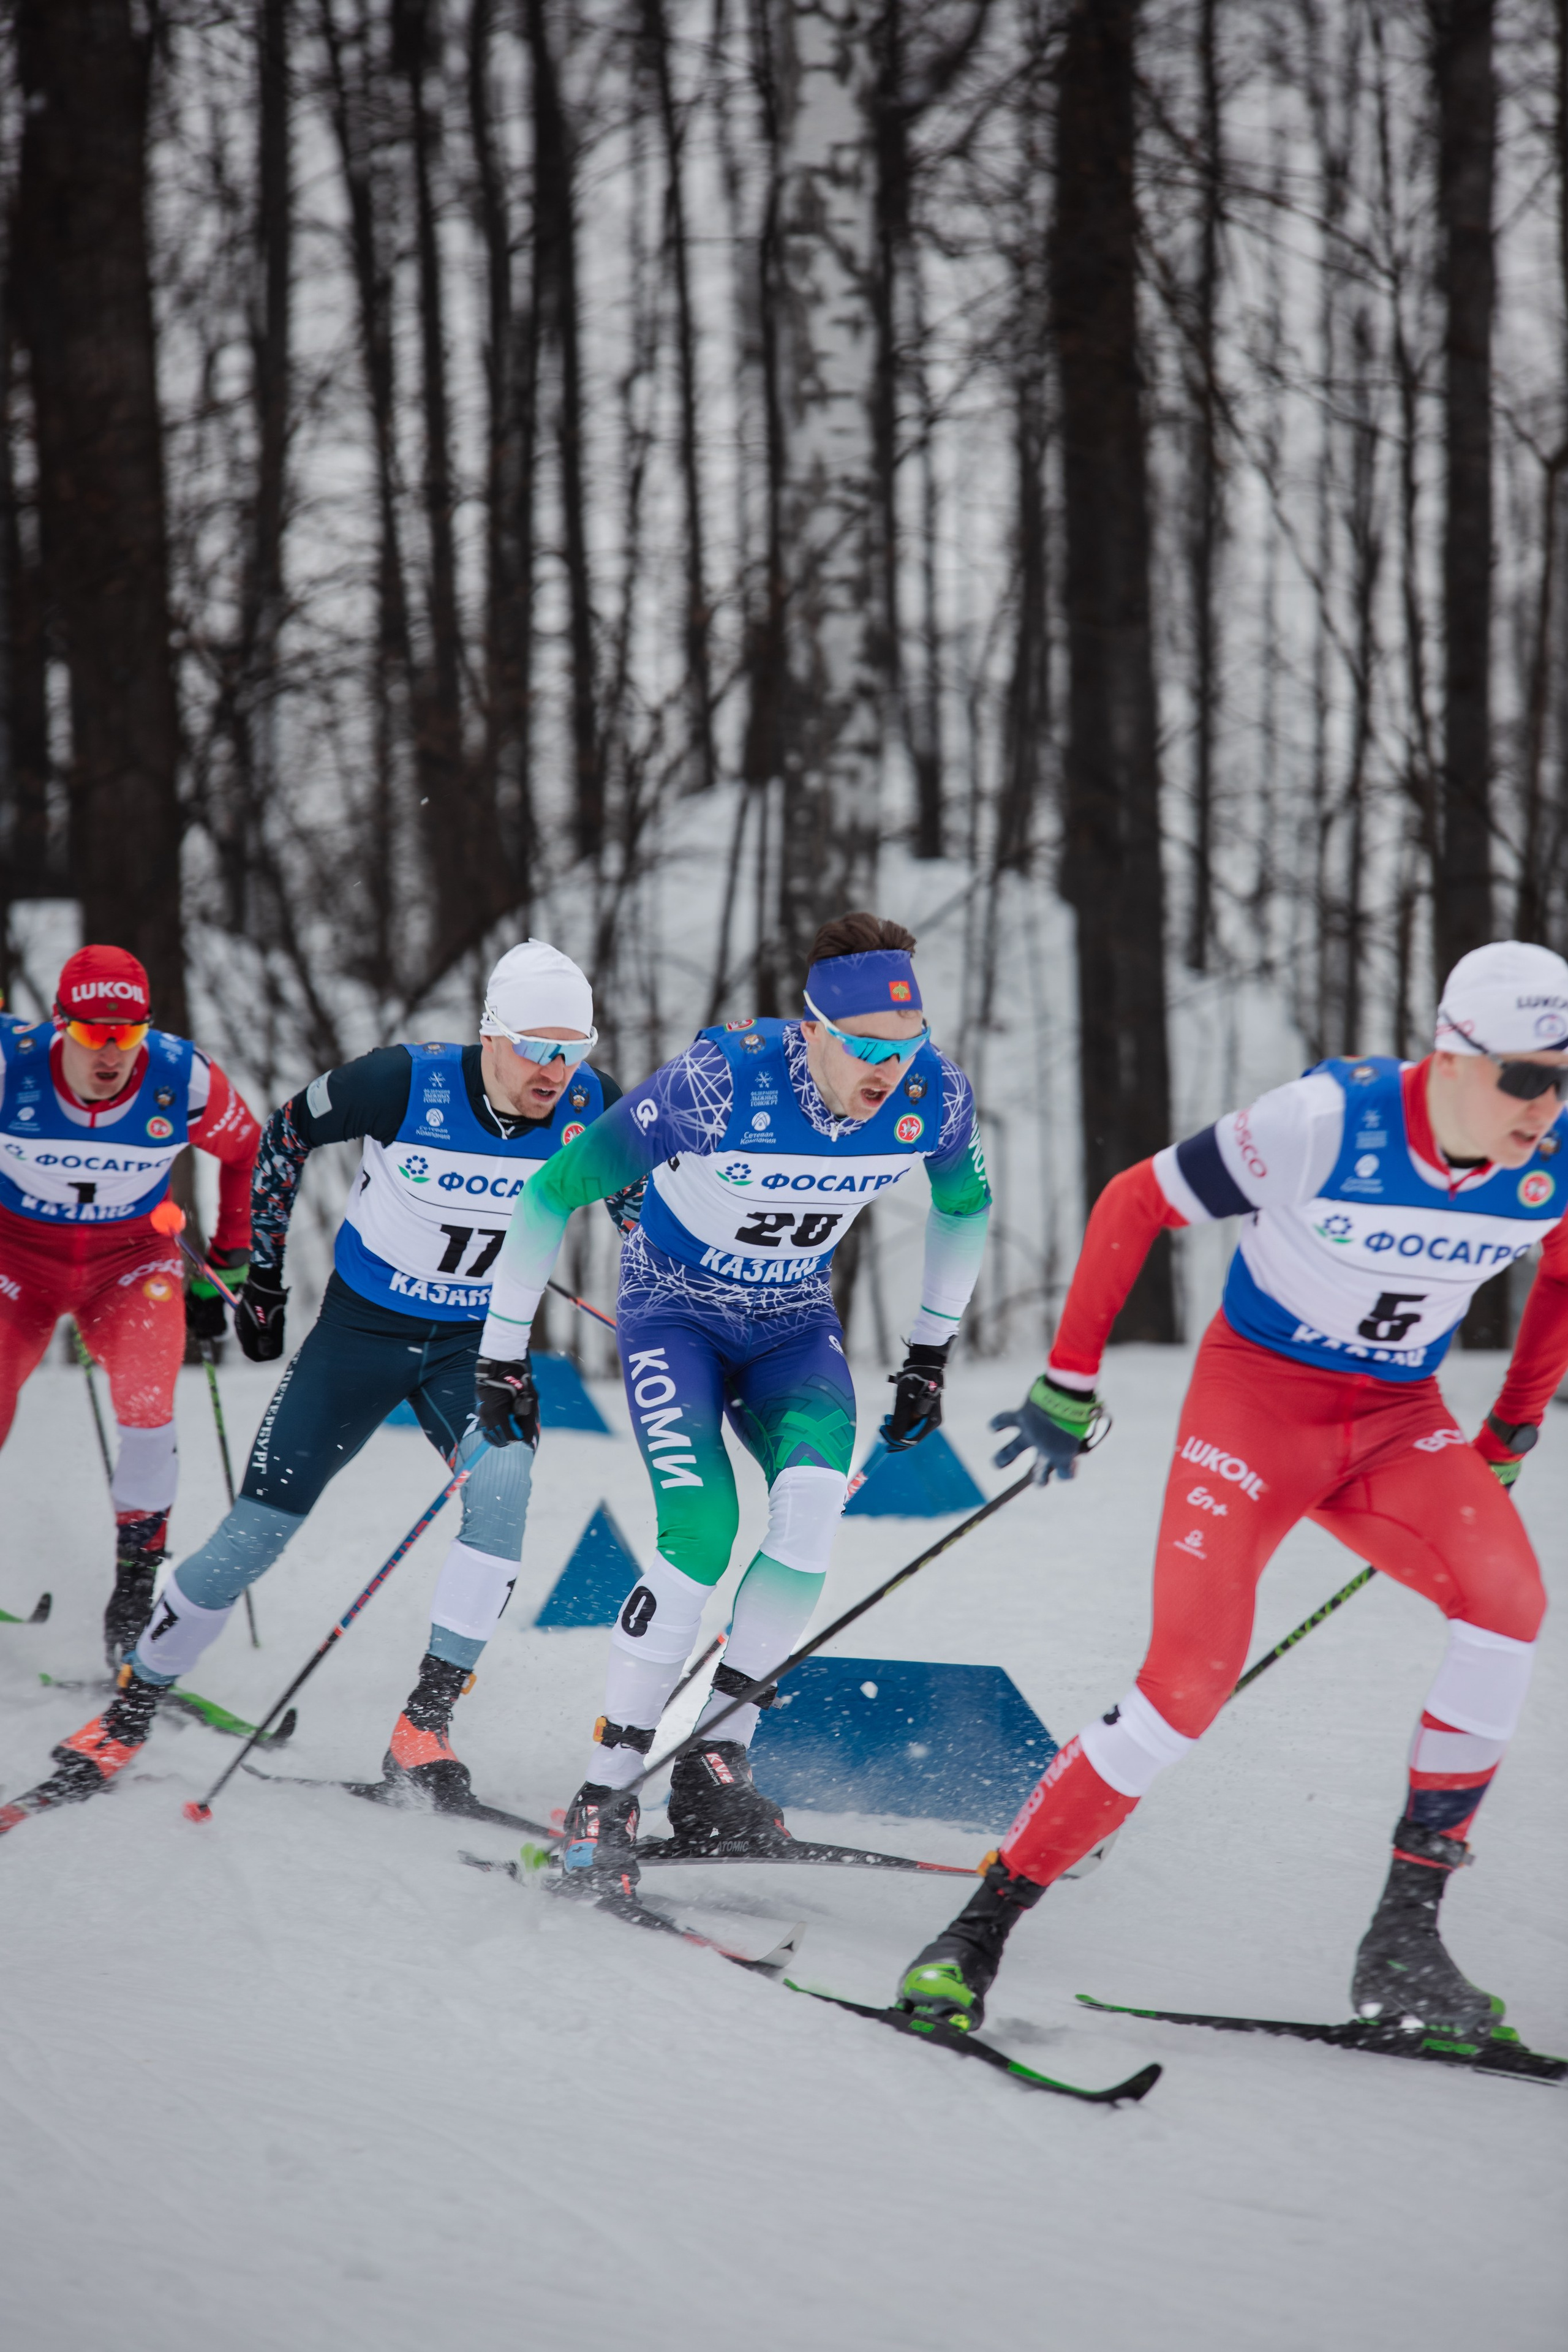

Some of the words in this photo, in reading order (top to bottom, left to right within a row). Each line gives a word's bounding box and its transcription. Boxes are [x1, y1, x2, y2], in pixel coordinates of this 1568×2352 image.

[71, 981, 145, 1004] LUKOIL
[67, 1182, 96, 1203] 1
[734, 1212, 843, 1247] 20
[437, 1224, 507, 1278] 17
[699, 1246, 821, 1283] КАЗАНЬ
[1358, 1292, 1430, 1341] 5
[1181, 1436, 1264, 1501] LUKOIL
[1186, 1486, 1228, 1517] En+
[615, 1586, 656, 1638] 0
[706, 1754, 734, 1784] KV+
[586, 1806, 600, 1836] KV+
[717, 1841, 749, 1852] ATOMIC
